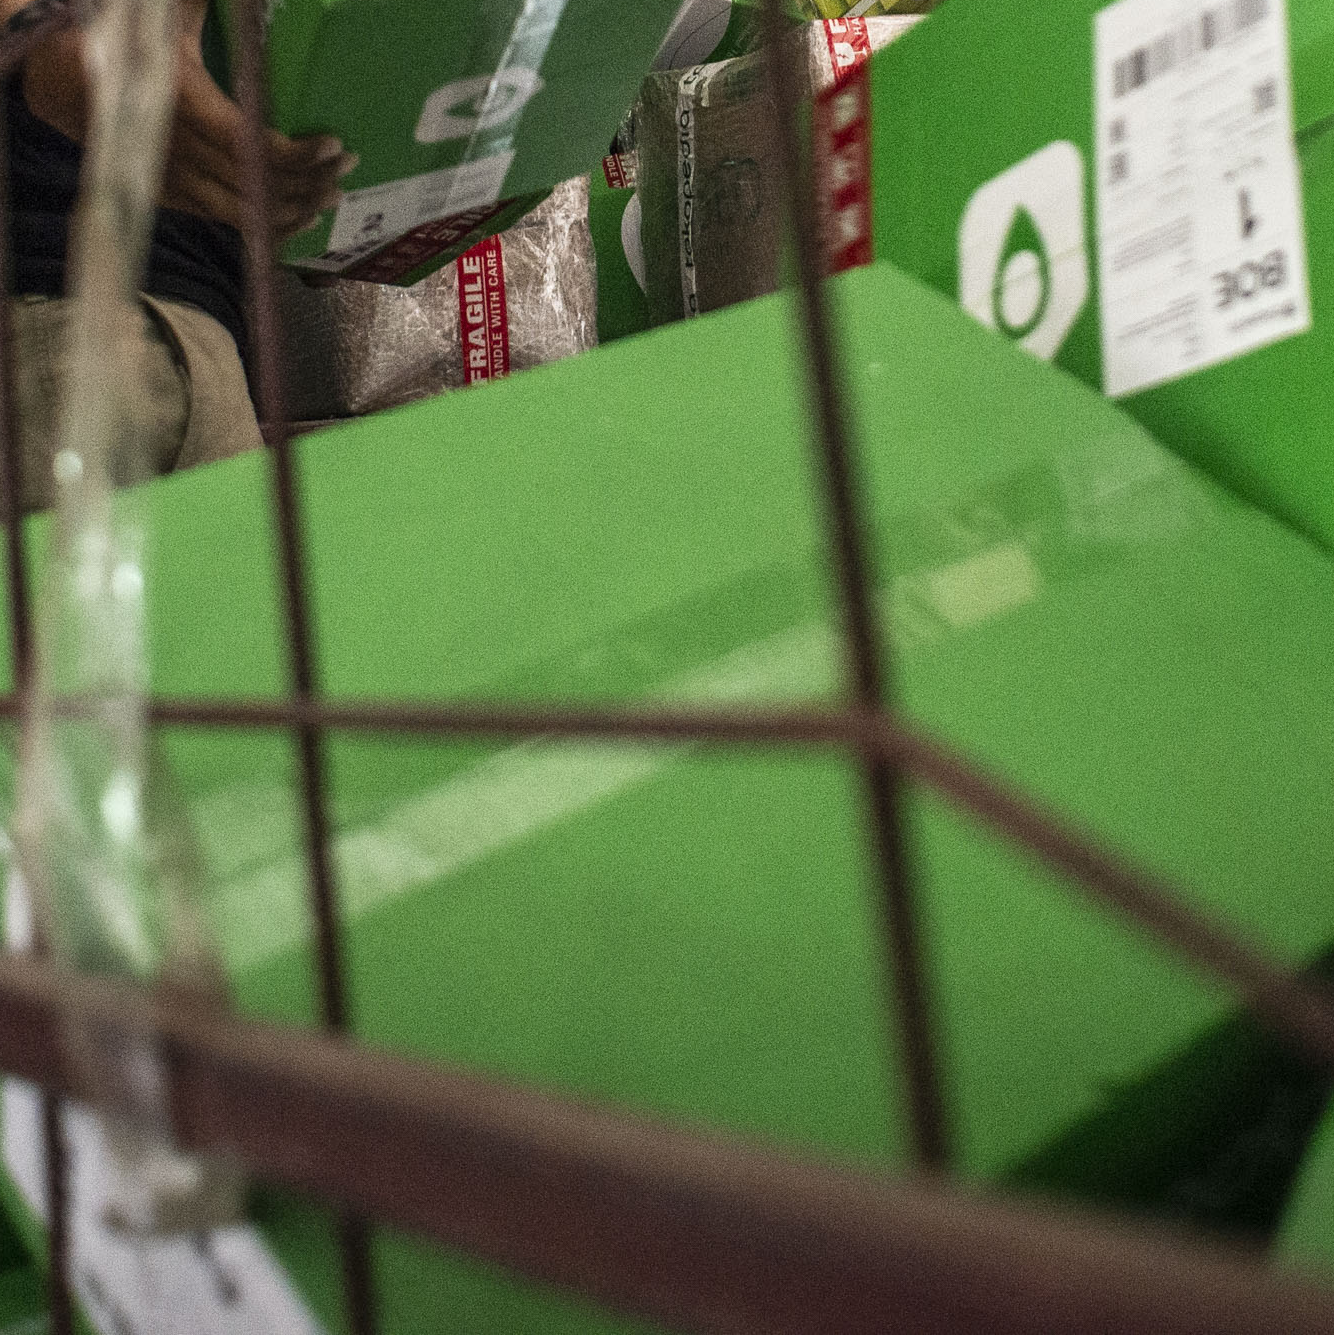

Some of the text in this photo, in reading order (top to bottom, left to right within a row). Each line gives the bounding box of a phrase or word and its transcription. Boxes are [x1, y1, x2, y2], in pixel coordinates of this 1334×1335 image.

[485, 249, 497, 287] CARE
[462, 255, 489, 385] FRAGILE
[488, 291, 501, 329] WITH
